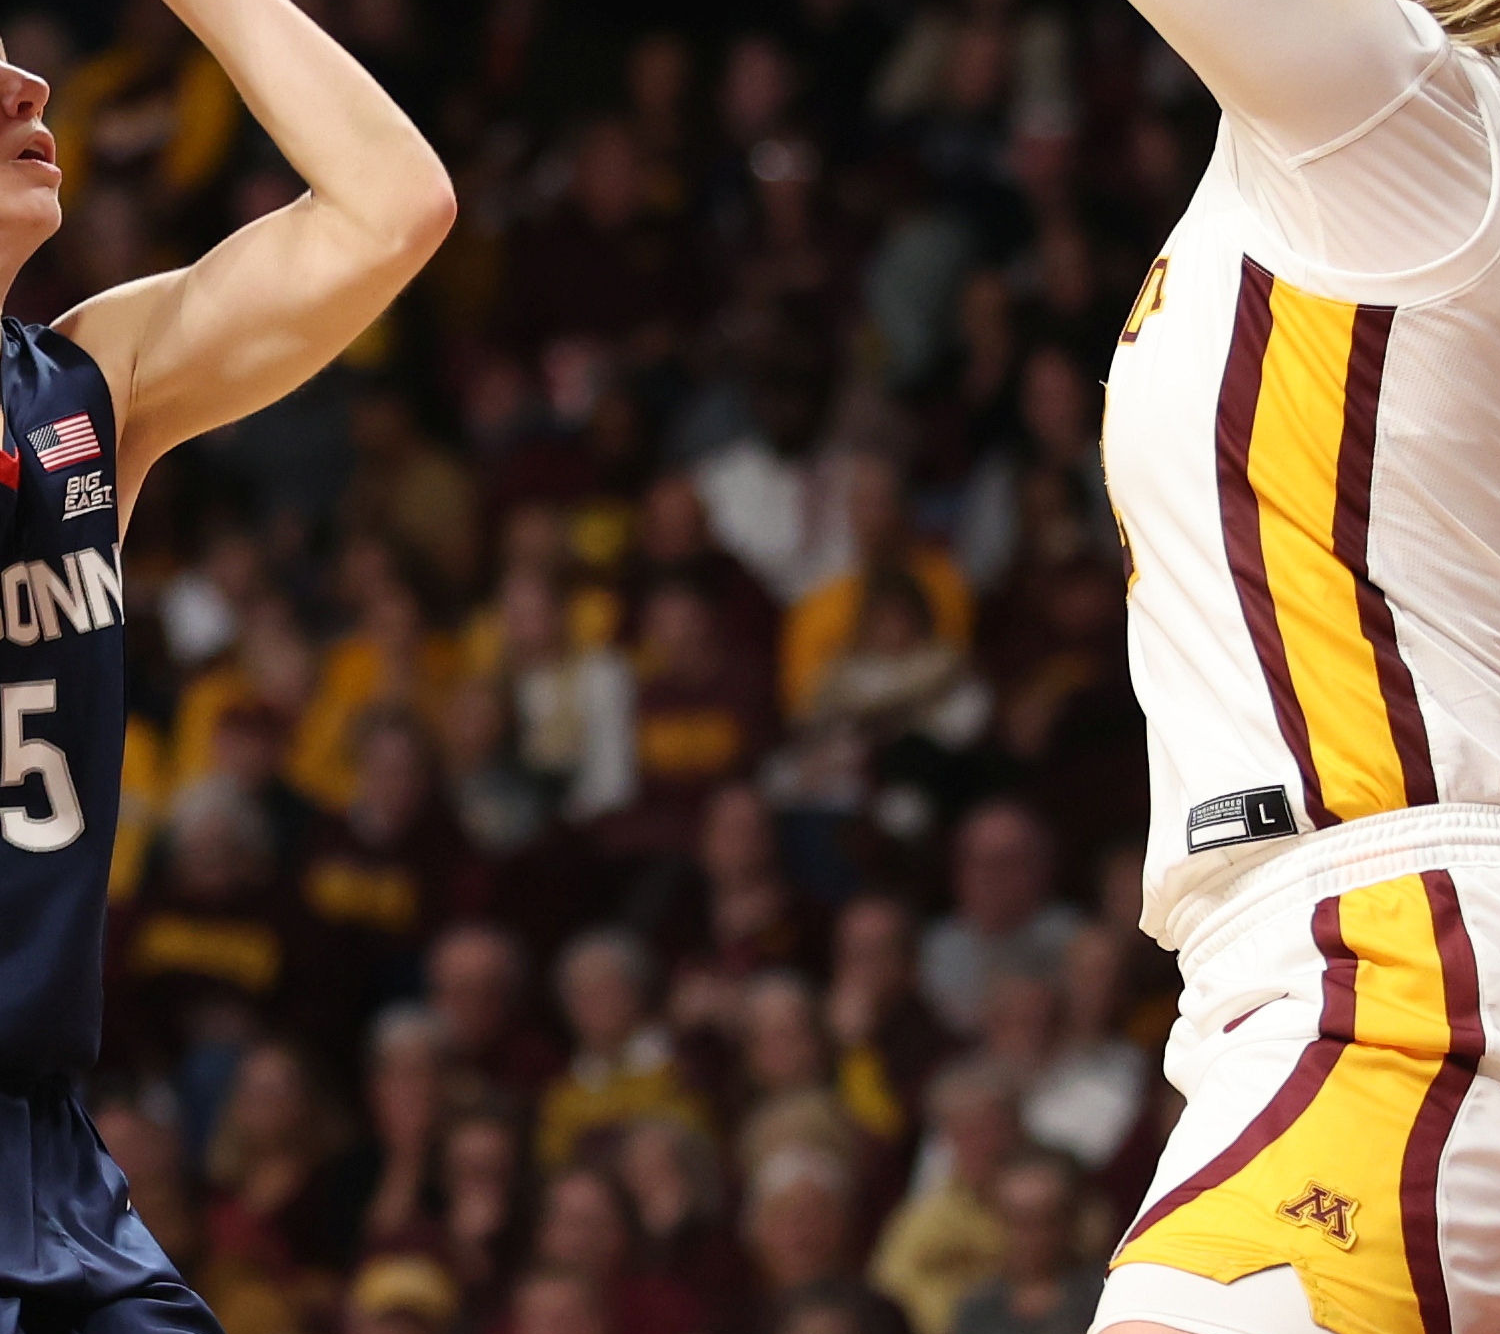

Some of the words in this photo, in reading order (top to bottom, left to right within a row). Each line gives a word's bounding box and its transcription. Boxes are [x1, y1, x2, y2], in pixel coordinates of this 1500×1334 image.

[66, 470, 103, 495] BIG
[64, 485, 114, 512] EAST
[0, 678, 86, 853] 5
[1258, 803, 1276, 824] L
